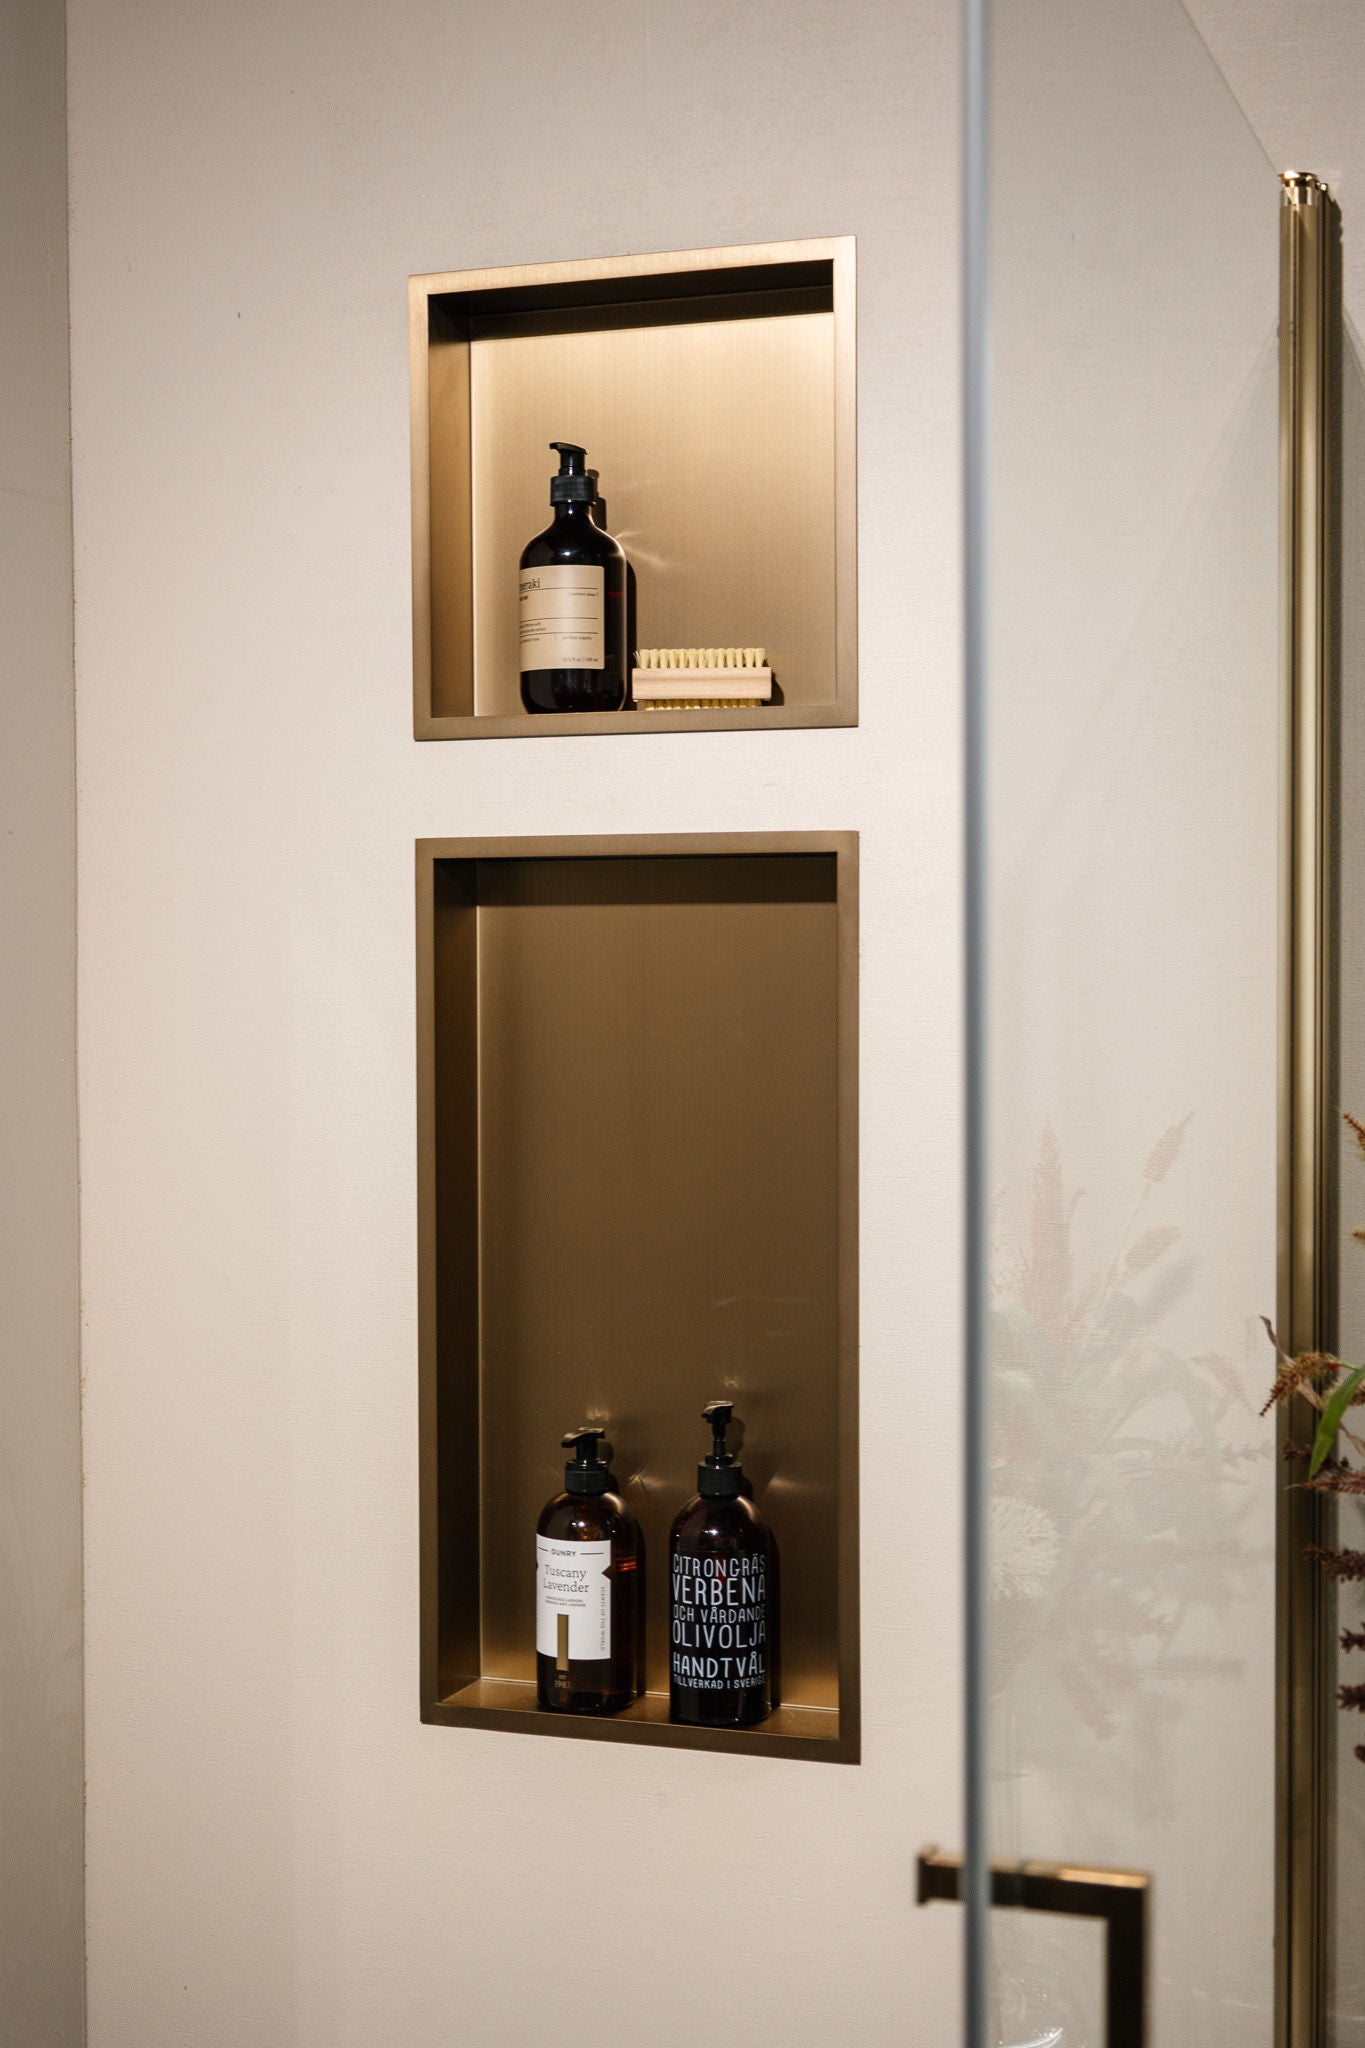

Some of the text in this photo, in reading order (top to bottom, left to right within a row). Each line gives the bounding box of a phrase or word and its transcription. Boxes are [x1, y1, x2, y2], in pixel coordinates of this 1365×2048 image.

[544, 1564, 588, 1582] Tuscany
[672, 1553, 766, 1578] CITRONGRÄS
[543, 1577, 591, 1593] Lavender
[672, 1573, 766, 1606] VERBENA
[672, 1603, 766, 1623] OCH VÅRDANDE
[672, 1619, 766, 1649] OLIVOLJA
[672, 1651, 766, 1678] HANDTVÅL
[672, 1673, 724, 1689] TILLVERKAD
[726, 1680, 731, 1689] I
